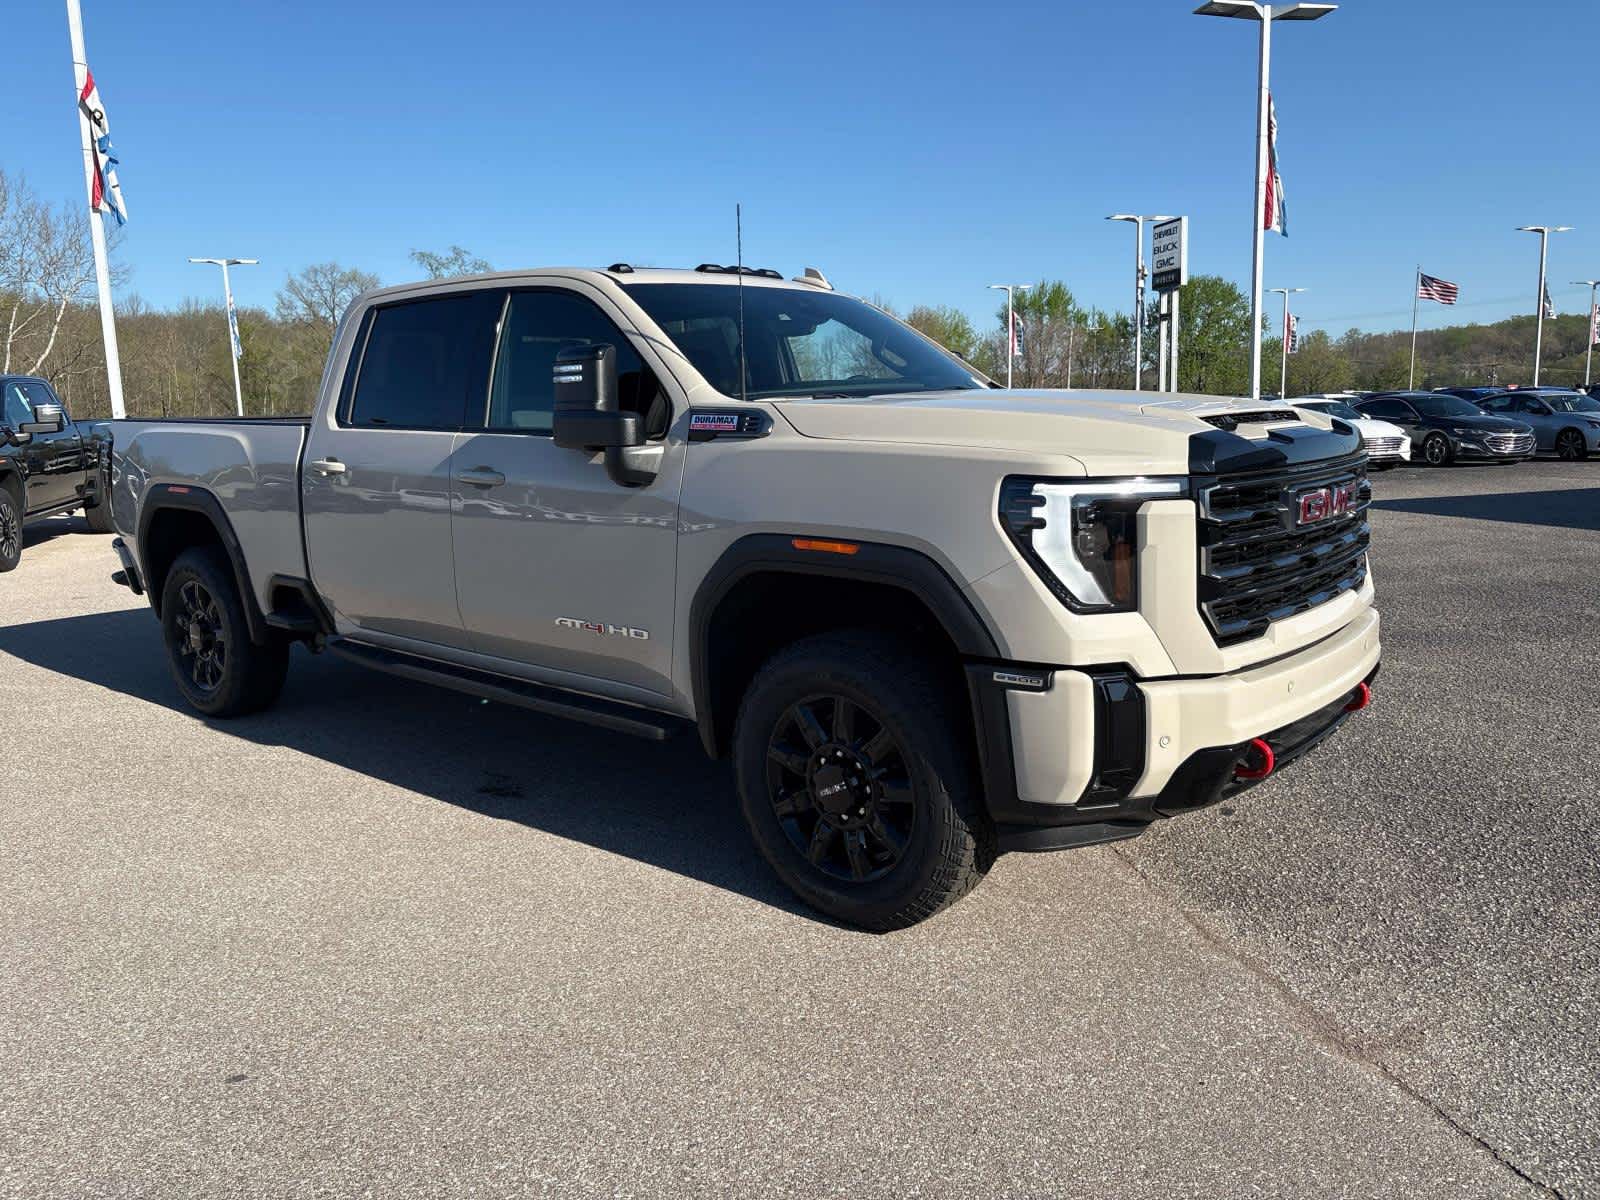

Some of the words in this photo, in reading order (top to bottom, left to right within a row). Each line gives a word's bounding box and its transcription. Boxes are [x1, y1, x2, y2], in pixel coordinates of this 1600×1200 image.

[1153, 241, 1177, 255] BUICK
[1156, 256, 1174, 269] GMC
[694, 415, 736, 424] DURAMAX
[1300, 483, 1357, 525] GMC
